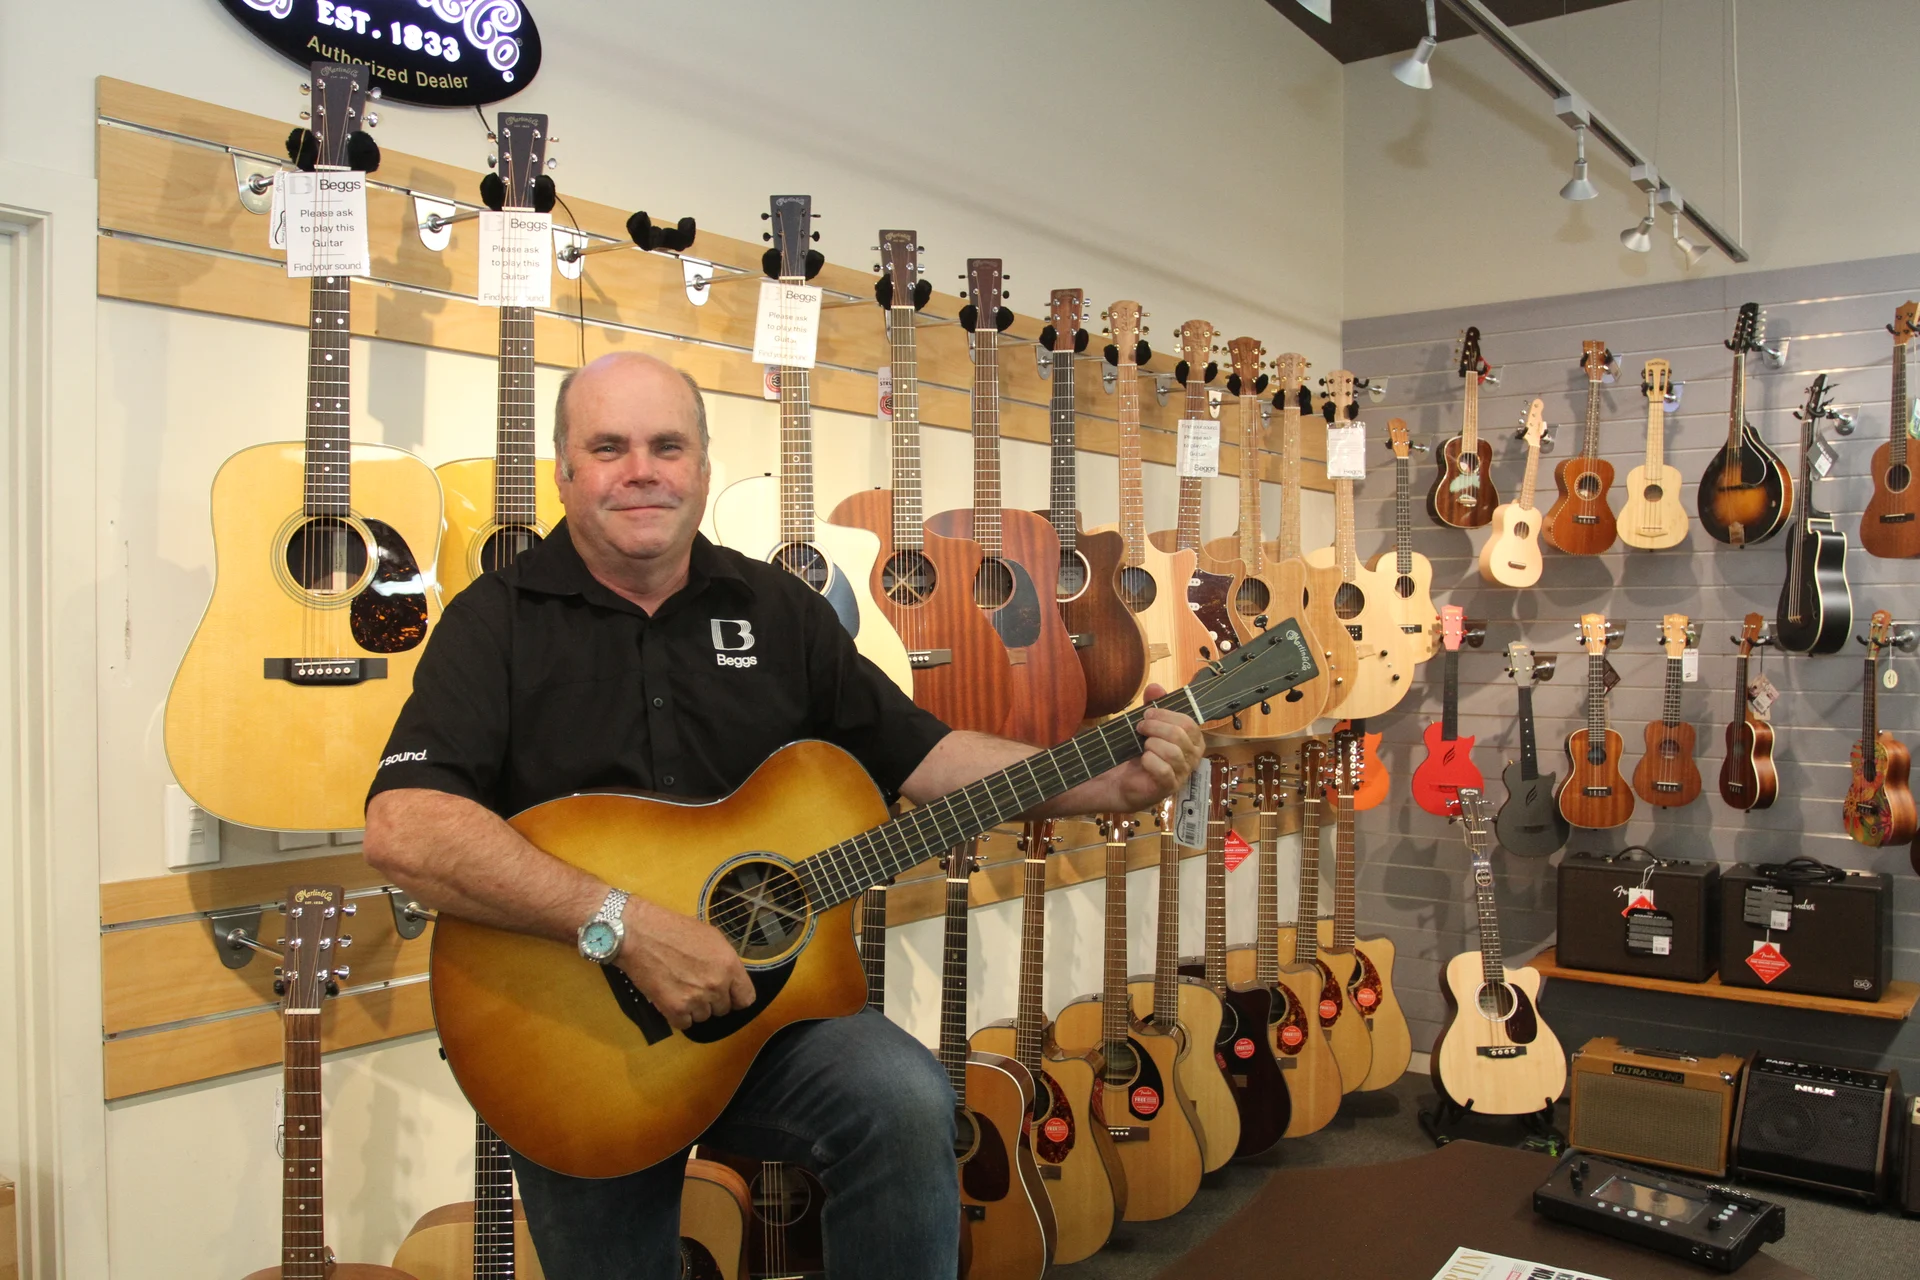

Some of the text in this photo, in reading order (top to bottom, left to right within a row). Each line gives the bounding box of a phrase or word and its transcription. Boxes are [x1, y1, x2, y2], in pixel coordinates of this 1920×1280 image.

[317, 0, 382, 39] EST.
[391, 22, 460, 63] 1833
[416, 70, 468, 88] Dealer
[319, 179, 361, 192] Beggs
[300, 208, 354, 217] Please ask
[300, 223, 355, 234] to play this
[510, 218, 548, 232] Beggs
[312, 239, 344, 247] Guitar
[492, 245, 522, 253] Please
[293, 262, 313, 271] Find
[313, 263, 333, 272] your
[491, 259, 540, 268] to play this
[501, 272, 529, 280] Guitar
[786, 290, 817, 304] Beggs
[769, 311, 794, 321] Please
[776, 325, 792, 333] play
[794, 325, 807, 333] this
[1194, 464, 1216, 473] Beggs
[717, 653, 757, 668] Beggs
[384, 749, 427, 766] sound.
[1613, 1065, 1683, 1082] ULTRASOUND
